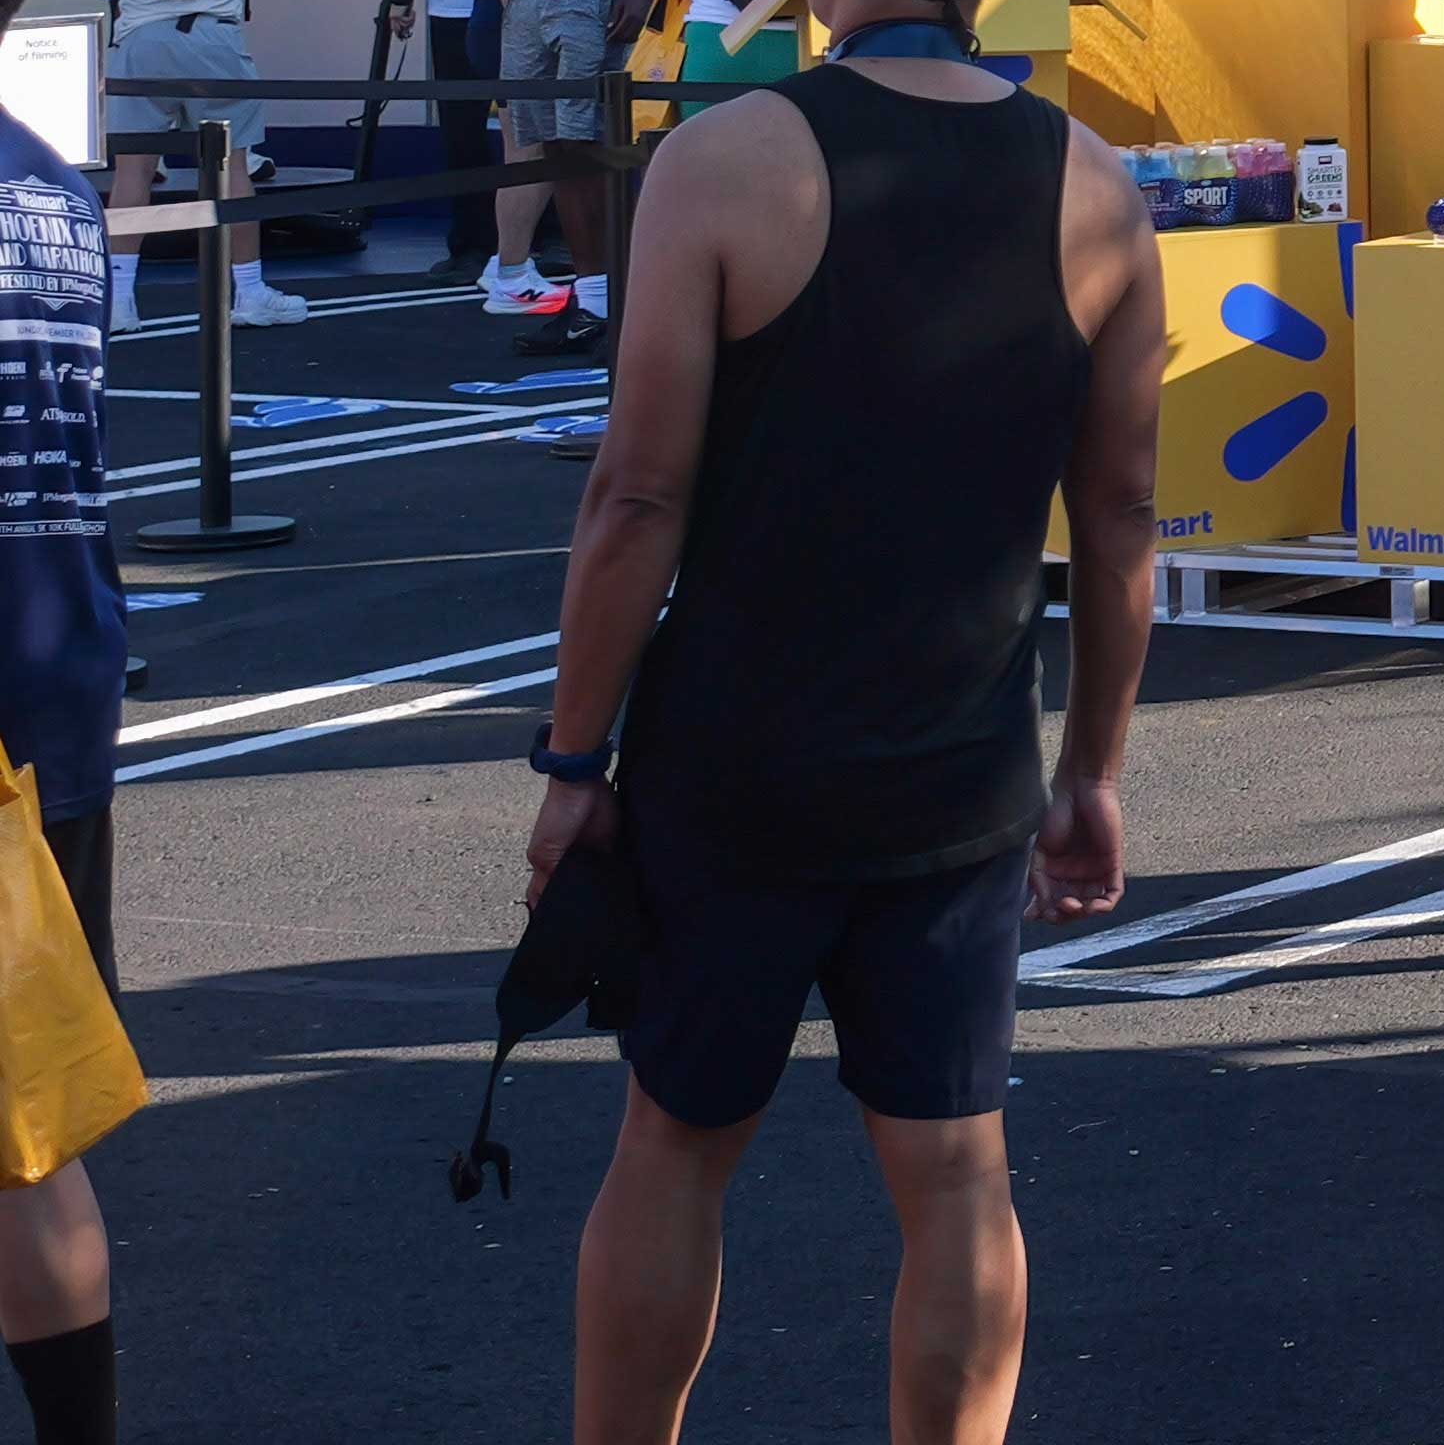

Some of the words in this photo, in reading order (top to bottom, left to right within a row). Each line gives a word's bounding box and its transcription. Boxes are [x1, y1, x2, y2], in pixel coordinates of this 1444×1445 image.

[25, 39, 57, 47] Notice
[18, 53, 28, 61] of
[32, 51, 68, 61] filming
[1308, 173, 1343, 183] GREENS
[14, 189, 69, 211] Walmart
[1183, 186, 1229, 206] SPORT
[0, 211, 75, 246] HOENIX
[75, 221, 104, 254] 10K
